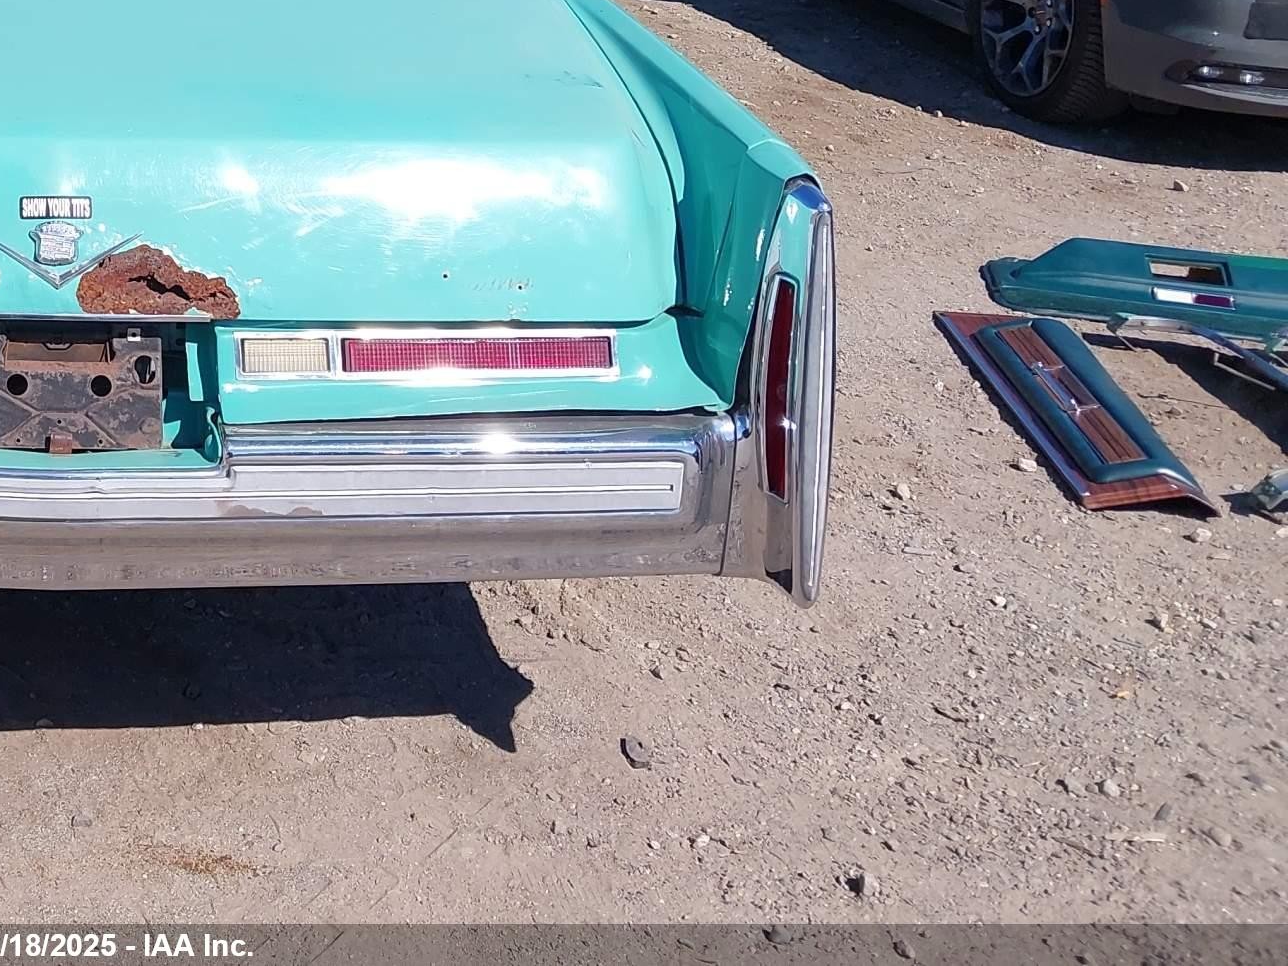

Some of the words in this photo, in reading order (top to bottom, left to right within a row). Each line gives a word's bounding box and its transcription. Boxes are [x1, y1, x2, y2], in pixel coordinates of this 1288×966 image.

[22, 198, 47, 218] SHOW
[47, 198, 71, 218] YOUR
[71, 198, 91, 218] TITS
